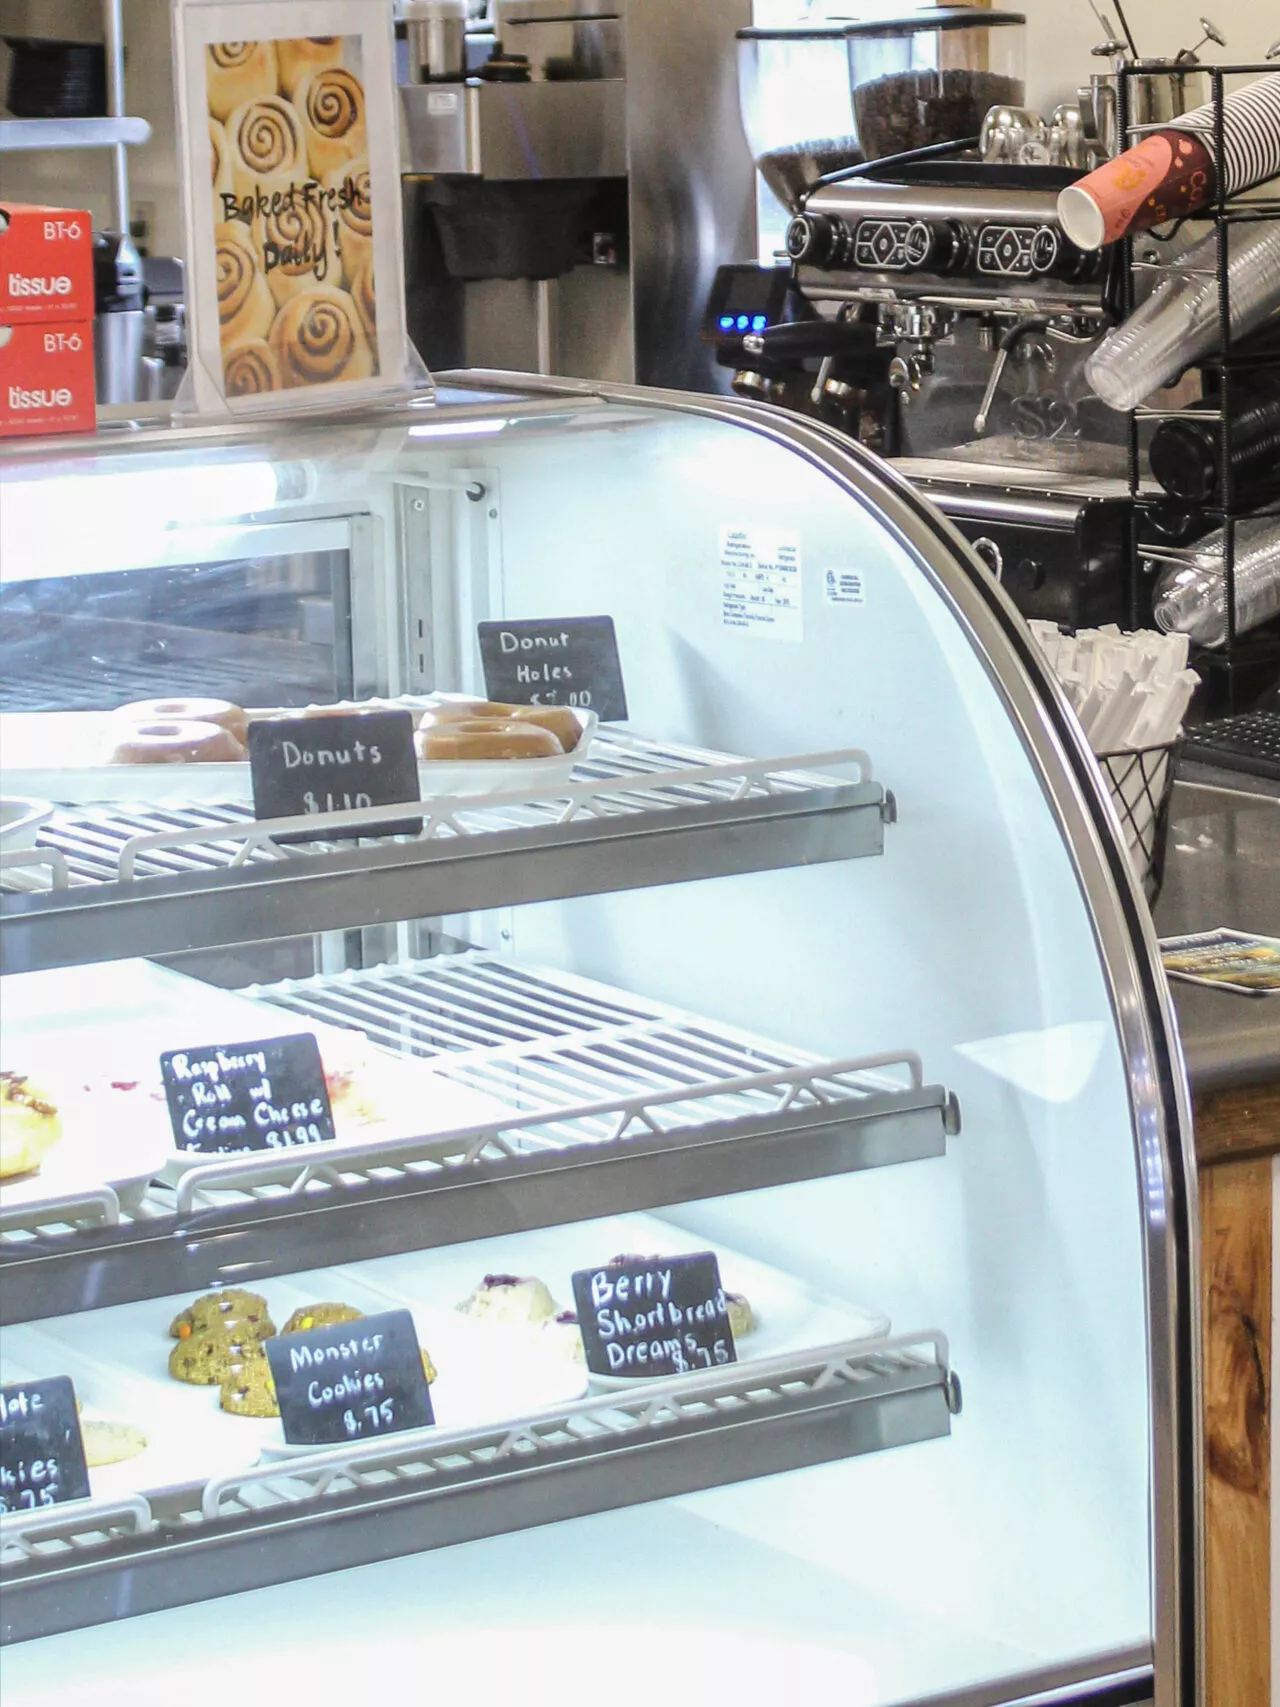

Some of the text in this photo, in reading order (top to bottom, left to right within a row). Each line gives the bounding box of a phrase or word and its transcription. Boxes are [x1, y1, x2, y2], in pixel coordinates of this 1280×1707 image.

[219, 176, 363, 222] Baked Fresh
[43, 220, 83, 241] BT-6
[8, 273, 72, 297] tissue
[43, 333, 83, 352] BT-6
[8, 386, 72, 409] tissue
[500, 631, 570, 653] Donut
[516, 663, 573, 683] Holes
[282, 740, 382, 769] Donuts
[253, 1098, 324, 1127] Cheese
[591, 1269, 672, 1307] Berry
[596, 1288, 727, 1340] Shortbread
[289, 1334, 384, 1373] Monster
[307, 1370, 385, 1408] Cookies
